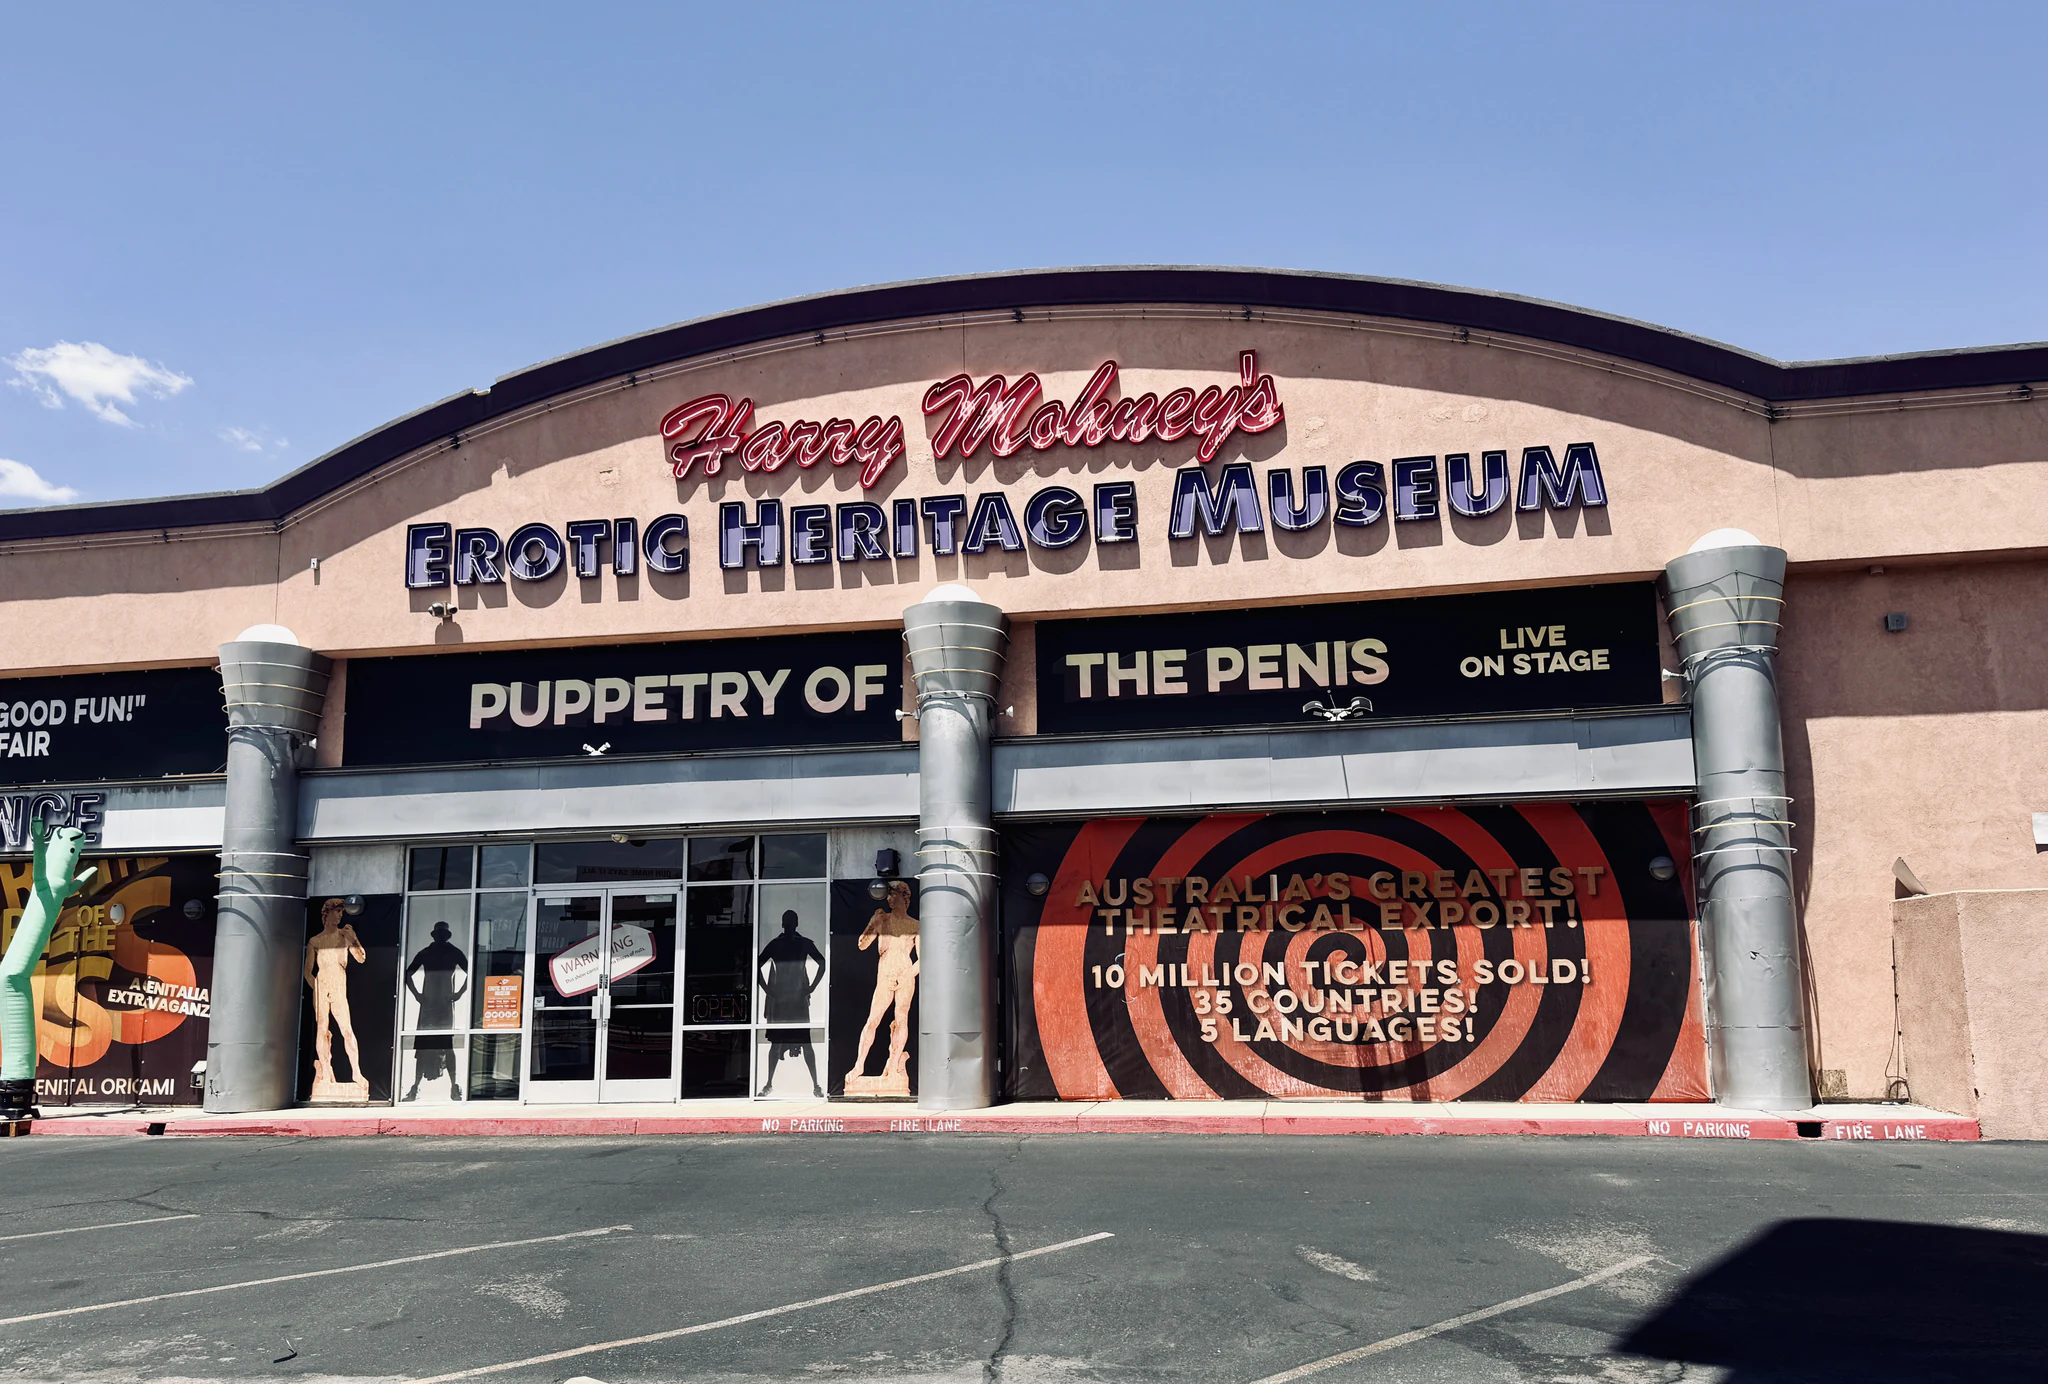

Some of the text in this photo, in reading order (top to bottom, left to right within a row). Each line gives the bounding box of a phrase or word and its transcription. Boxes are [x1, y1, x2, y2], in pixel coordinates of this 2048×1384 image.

[660, 349, 1284, 489] Harry Mohney's
[405, 442, 1608, 589] EROTIC HERITAGE MUSEUM
[1500, 625, 1566, 650] LIVE
[1066, 638, 1390, 699] THE PENIS
[1460, 649, 1610, 678] ON STAGE
[74, 694, 146, 724] FUN!"
[470, 664, 887, 729] PUPPETRY OF
[1075, 866, 1604, 907] AUSTRALIA'S GREATEST
[77, 904, 105, 927] OF
[1098, 899, 1578, 936] THEATRICAL EXPORT!
[65, 925, 116, 951] THE
[129, 978, 141, 991] A
[1091, 958, 1591, 988] 10 MILLION TICKETS SOLD!
[108, 989, 211, 1018] EXTRVAGANZ
[696, 998, 744, 1018] OPEN
[1194, 988, 1478, 1015] 35 COUNTRIES!
[1200, 1017, 1476, 1043] 5 LANGUAGES!
[34, 1078, 97, 1096] ENITAL
[762, 1118, 844, 1132] NO PARKING
[890, 1119, 962, 1132] FIRE LANE
[1649, 1120, 1750, 1138] NO PARKING
[1836, 1124, 1926, 1140] FIRE LANE
